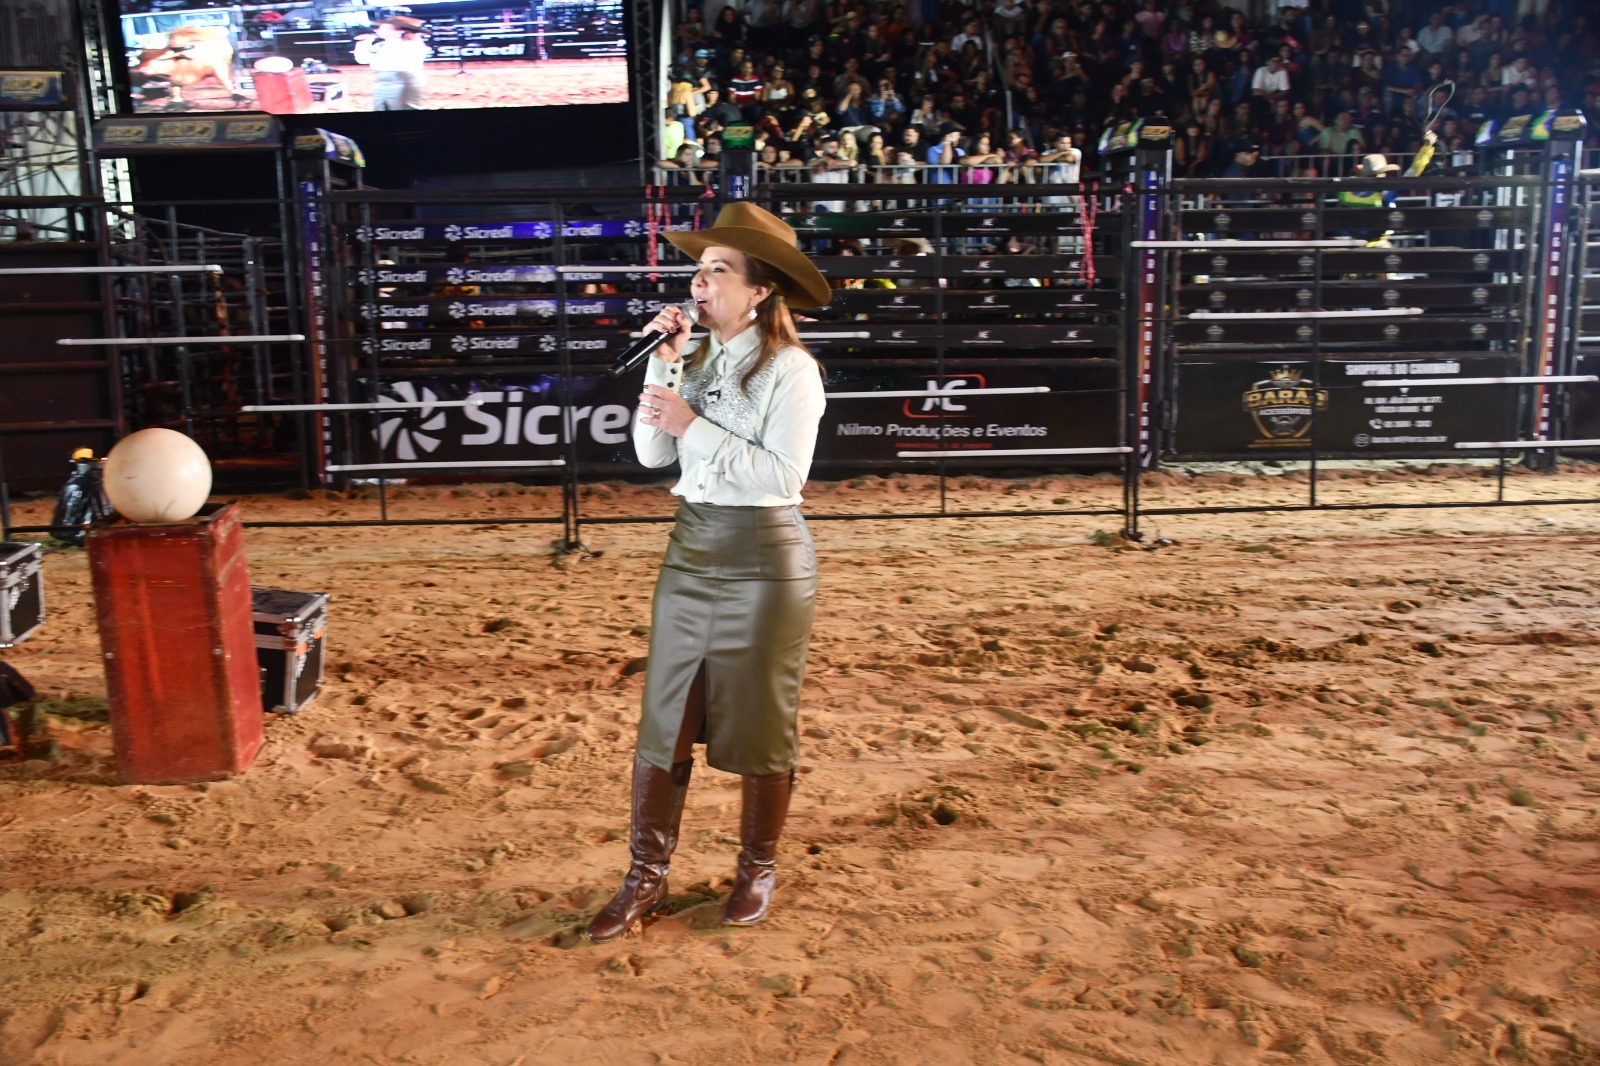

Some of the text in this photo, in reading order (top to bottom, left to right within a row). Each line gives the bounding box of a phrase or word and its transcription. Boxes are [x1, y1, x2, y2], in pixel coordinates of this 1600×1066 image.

[438, 44, 525, 57] Sicredi
[375, 227, 425, 240] Sicredi
[463, 226, 513, 239] Sicredi
[377, 270, 427, 283] Sicredi
[465, 269, 516, 282] Sicredi
[379, 304, 429, 317] Sicredi
[467, 303, 517, 316] Sicredi
[381, 337, 431, 350] Sicredi
[470, 337, 519, 349] Sicredi
[837, 423, 1048, 439] Nilmo Produções e Eventos
